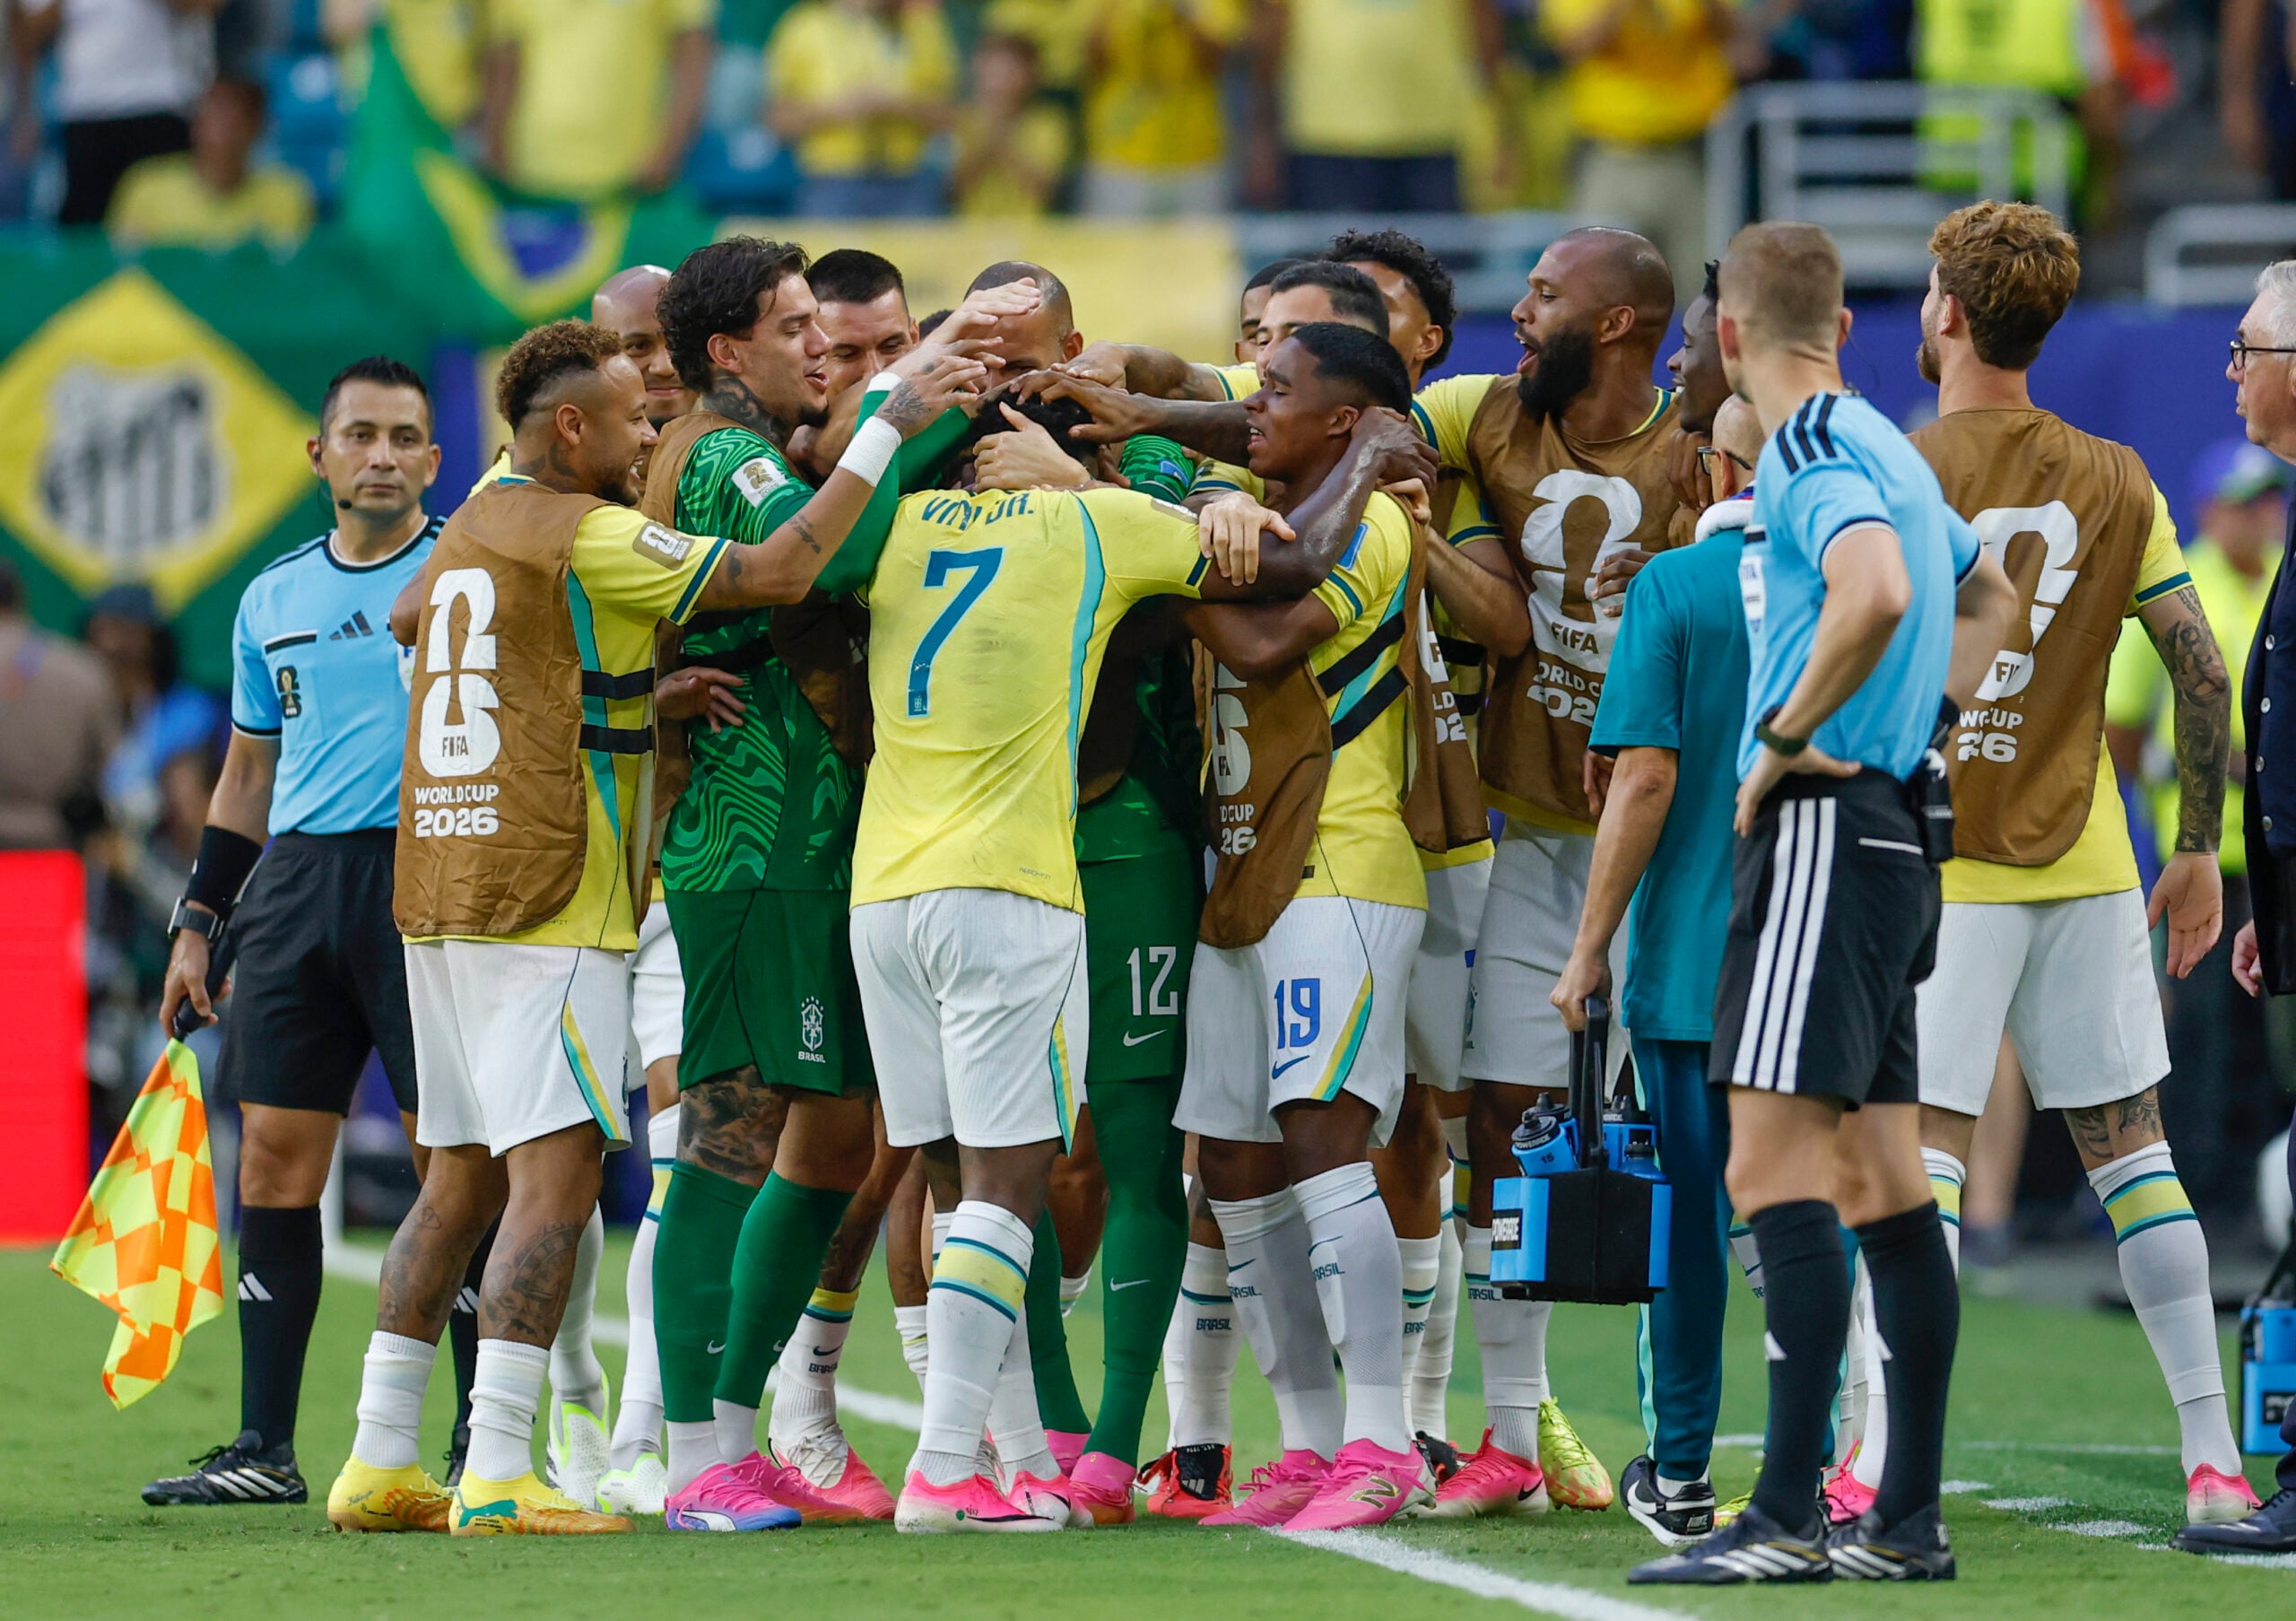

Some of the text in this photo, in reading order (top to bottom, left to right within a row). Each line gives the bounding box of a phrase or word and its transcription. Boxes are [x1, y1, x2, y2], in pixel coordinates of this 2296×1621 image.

[906, 546, 1005, 718] 7
[1551, 621, 1599, 655] FIFA
[1533, 661, 1586, 692] ORLD
[1526, 684, 1597, 728] 202
[441, 736, 469, 757] FIFA
[414, 784, 500, 806] WORLD CUP
[414, 806, 500, 838] 2026
[1126, 946, 1178, 1015] 12
[1274, 978, 1320, 1050] 19
[798, 1051, 826, 1063] BRASIL
[1541, 1153, 1554, 1163] 15
[1313, 1262, 1345, 1281] RASIL
[1227, 1285, 1263, 1298] RASIL
[1468, 1287, 1501, 1302] RASIL
